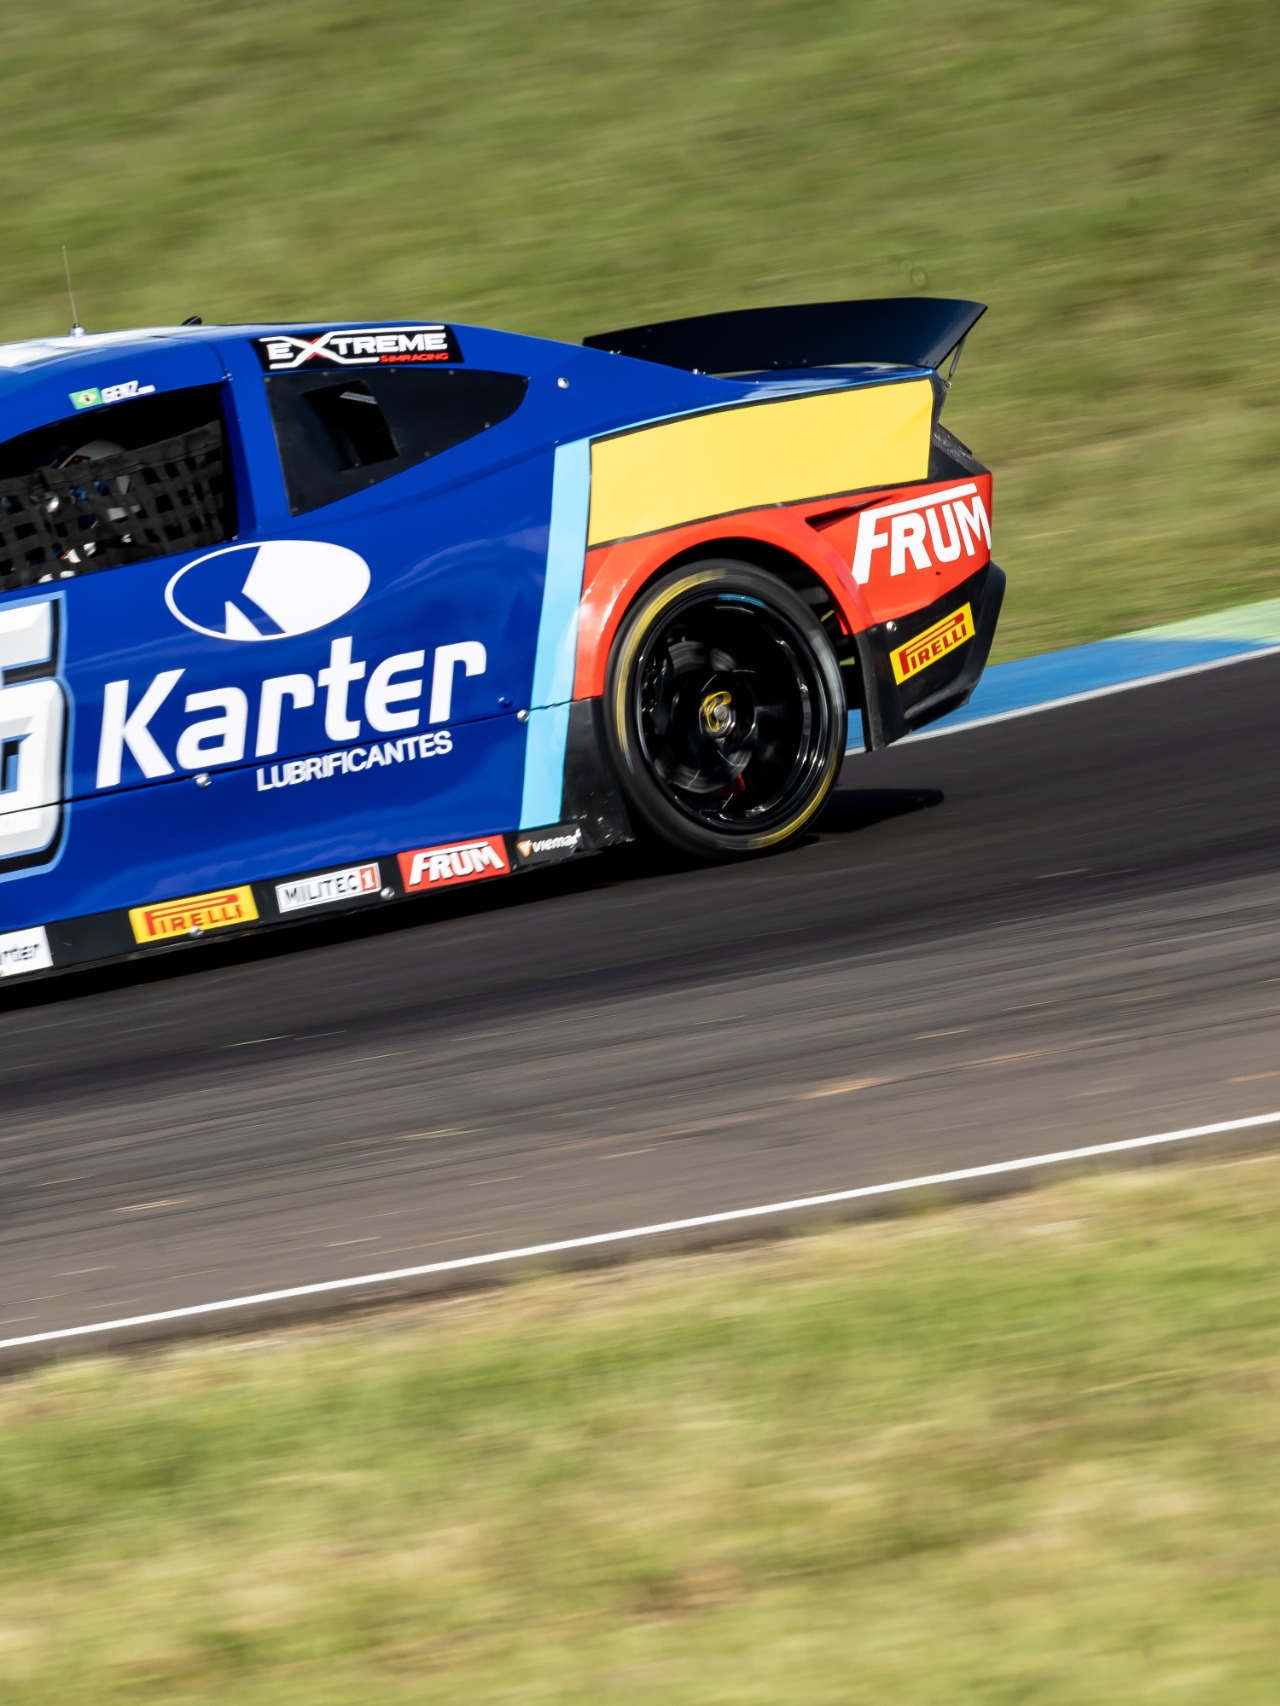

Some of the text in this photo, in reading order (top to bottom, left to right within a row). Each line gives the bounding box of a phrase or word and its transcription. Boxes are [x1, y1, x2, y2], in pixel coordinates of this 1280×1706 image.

[259, 325, 448, 370] EXTREME
[379, 352, 449, 363] SIMRACING
[852, 483, 992, 585] FRUM
[898, 612, 967, 675] PIRELLI
[96, 636, 487, 789] Karter
[256, 730, 453, 791] LUBRIFICANTES
[409, 841, 505, 885] FRUM
[144, 893, 244, 936] PIRELLI
